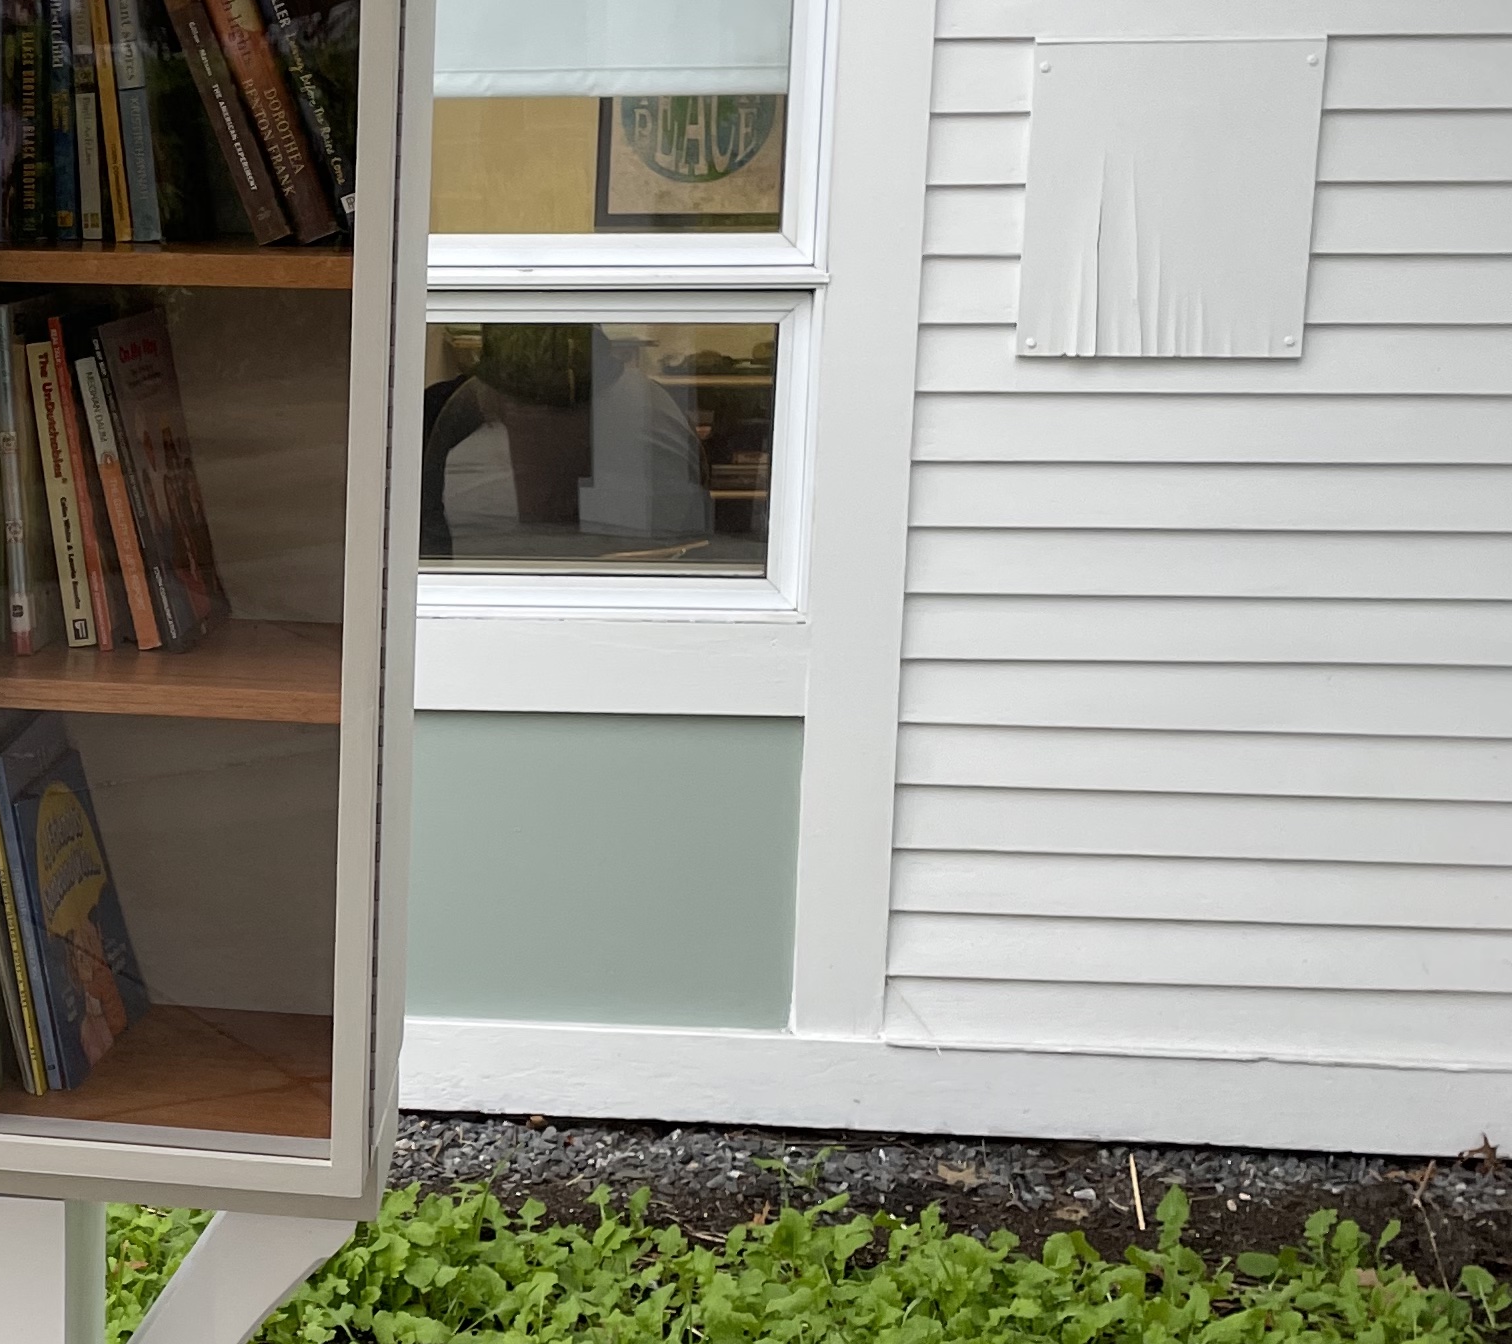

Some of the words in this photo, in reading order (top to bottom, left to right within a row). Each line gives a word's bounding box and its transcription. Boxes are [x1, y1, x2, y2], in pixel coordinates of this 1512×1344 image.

[21, 31, 34, 65] BLACK
[210, 82, 223, 101] THE
[22, 126, 35, 159] BLACK
[240, 77, 276, 141] BENTON
[265, 143, 298, 199] FRANK
[262, 86, 307, 177] DOROTHEA
[634, 96, 758, 175] PEACE
[22, 163, 35, 210] BROTHER
[36, 352, 52, 378] The
